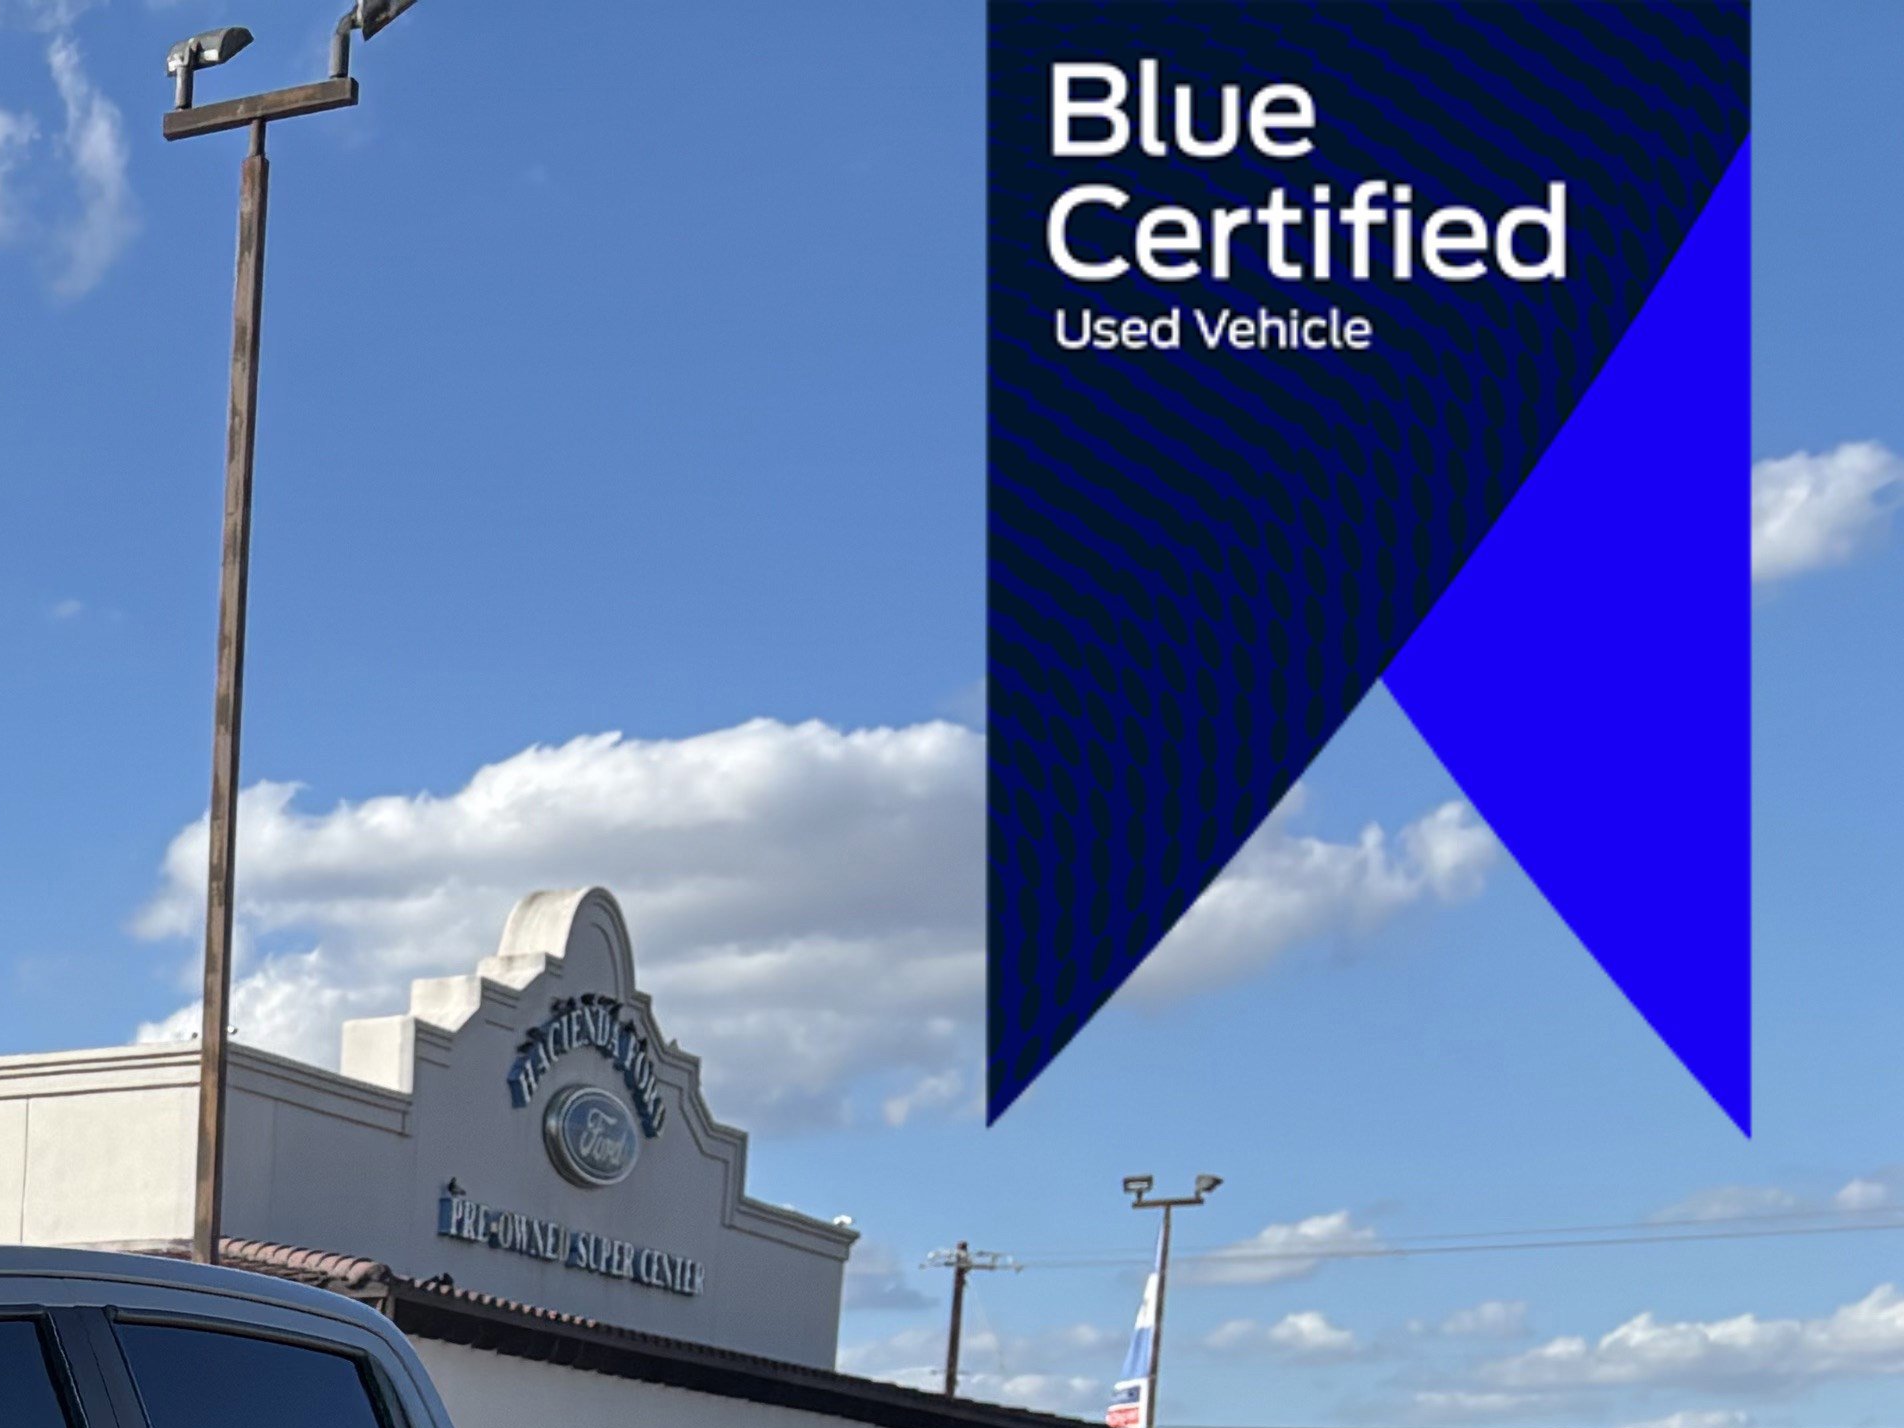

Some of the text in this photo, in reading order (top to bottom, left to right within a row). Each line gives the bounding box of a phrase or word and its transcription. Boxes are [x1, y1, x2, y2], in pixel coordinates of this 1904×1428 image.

[447, 1198, 706, 1296] PRE-OWNED SUPER CENTER
